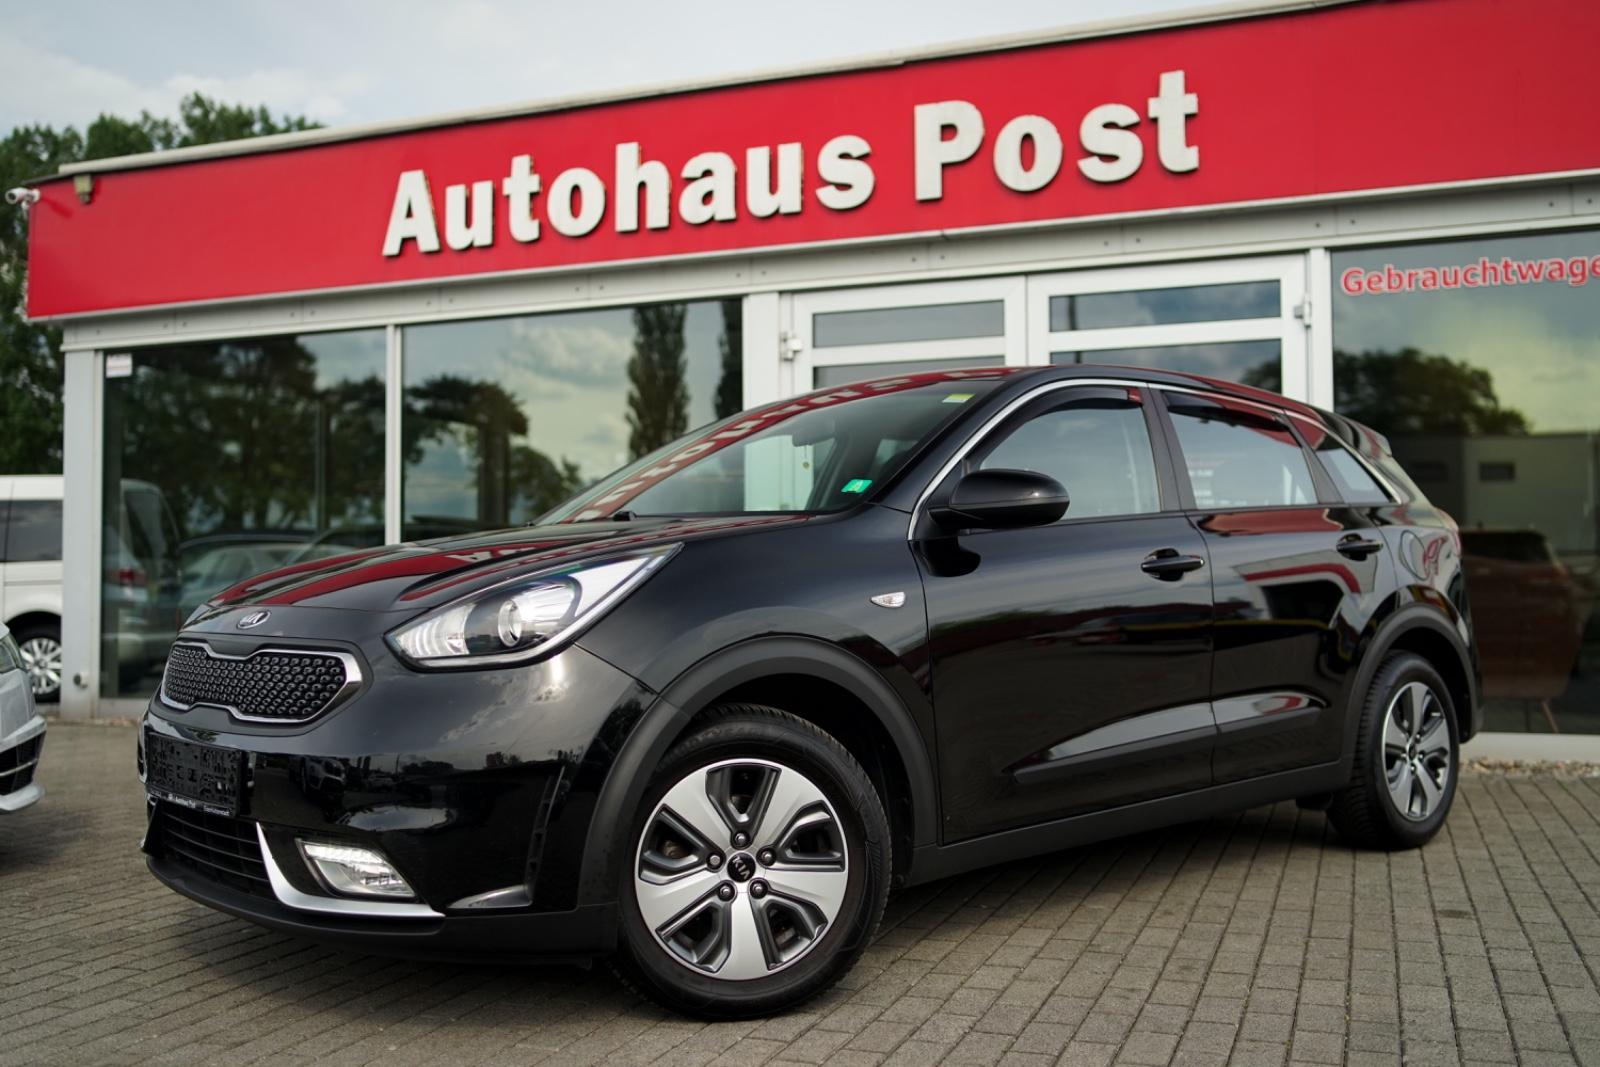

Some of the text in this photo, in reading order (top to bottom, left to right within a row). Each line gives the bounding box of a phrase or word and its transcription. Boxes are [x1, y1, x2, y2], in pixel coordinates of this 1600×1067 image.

[382, 70, 1200, 257] Autohaus Post
[731, 855, 751, 881] KIA
